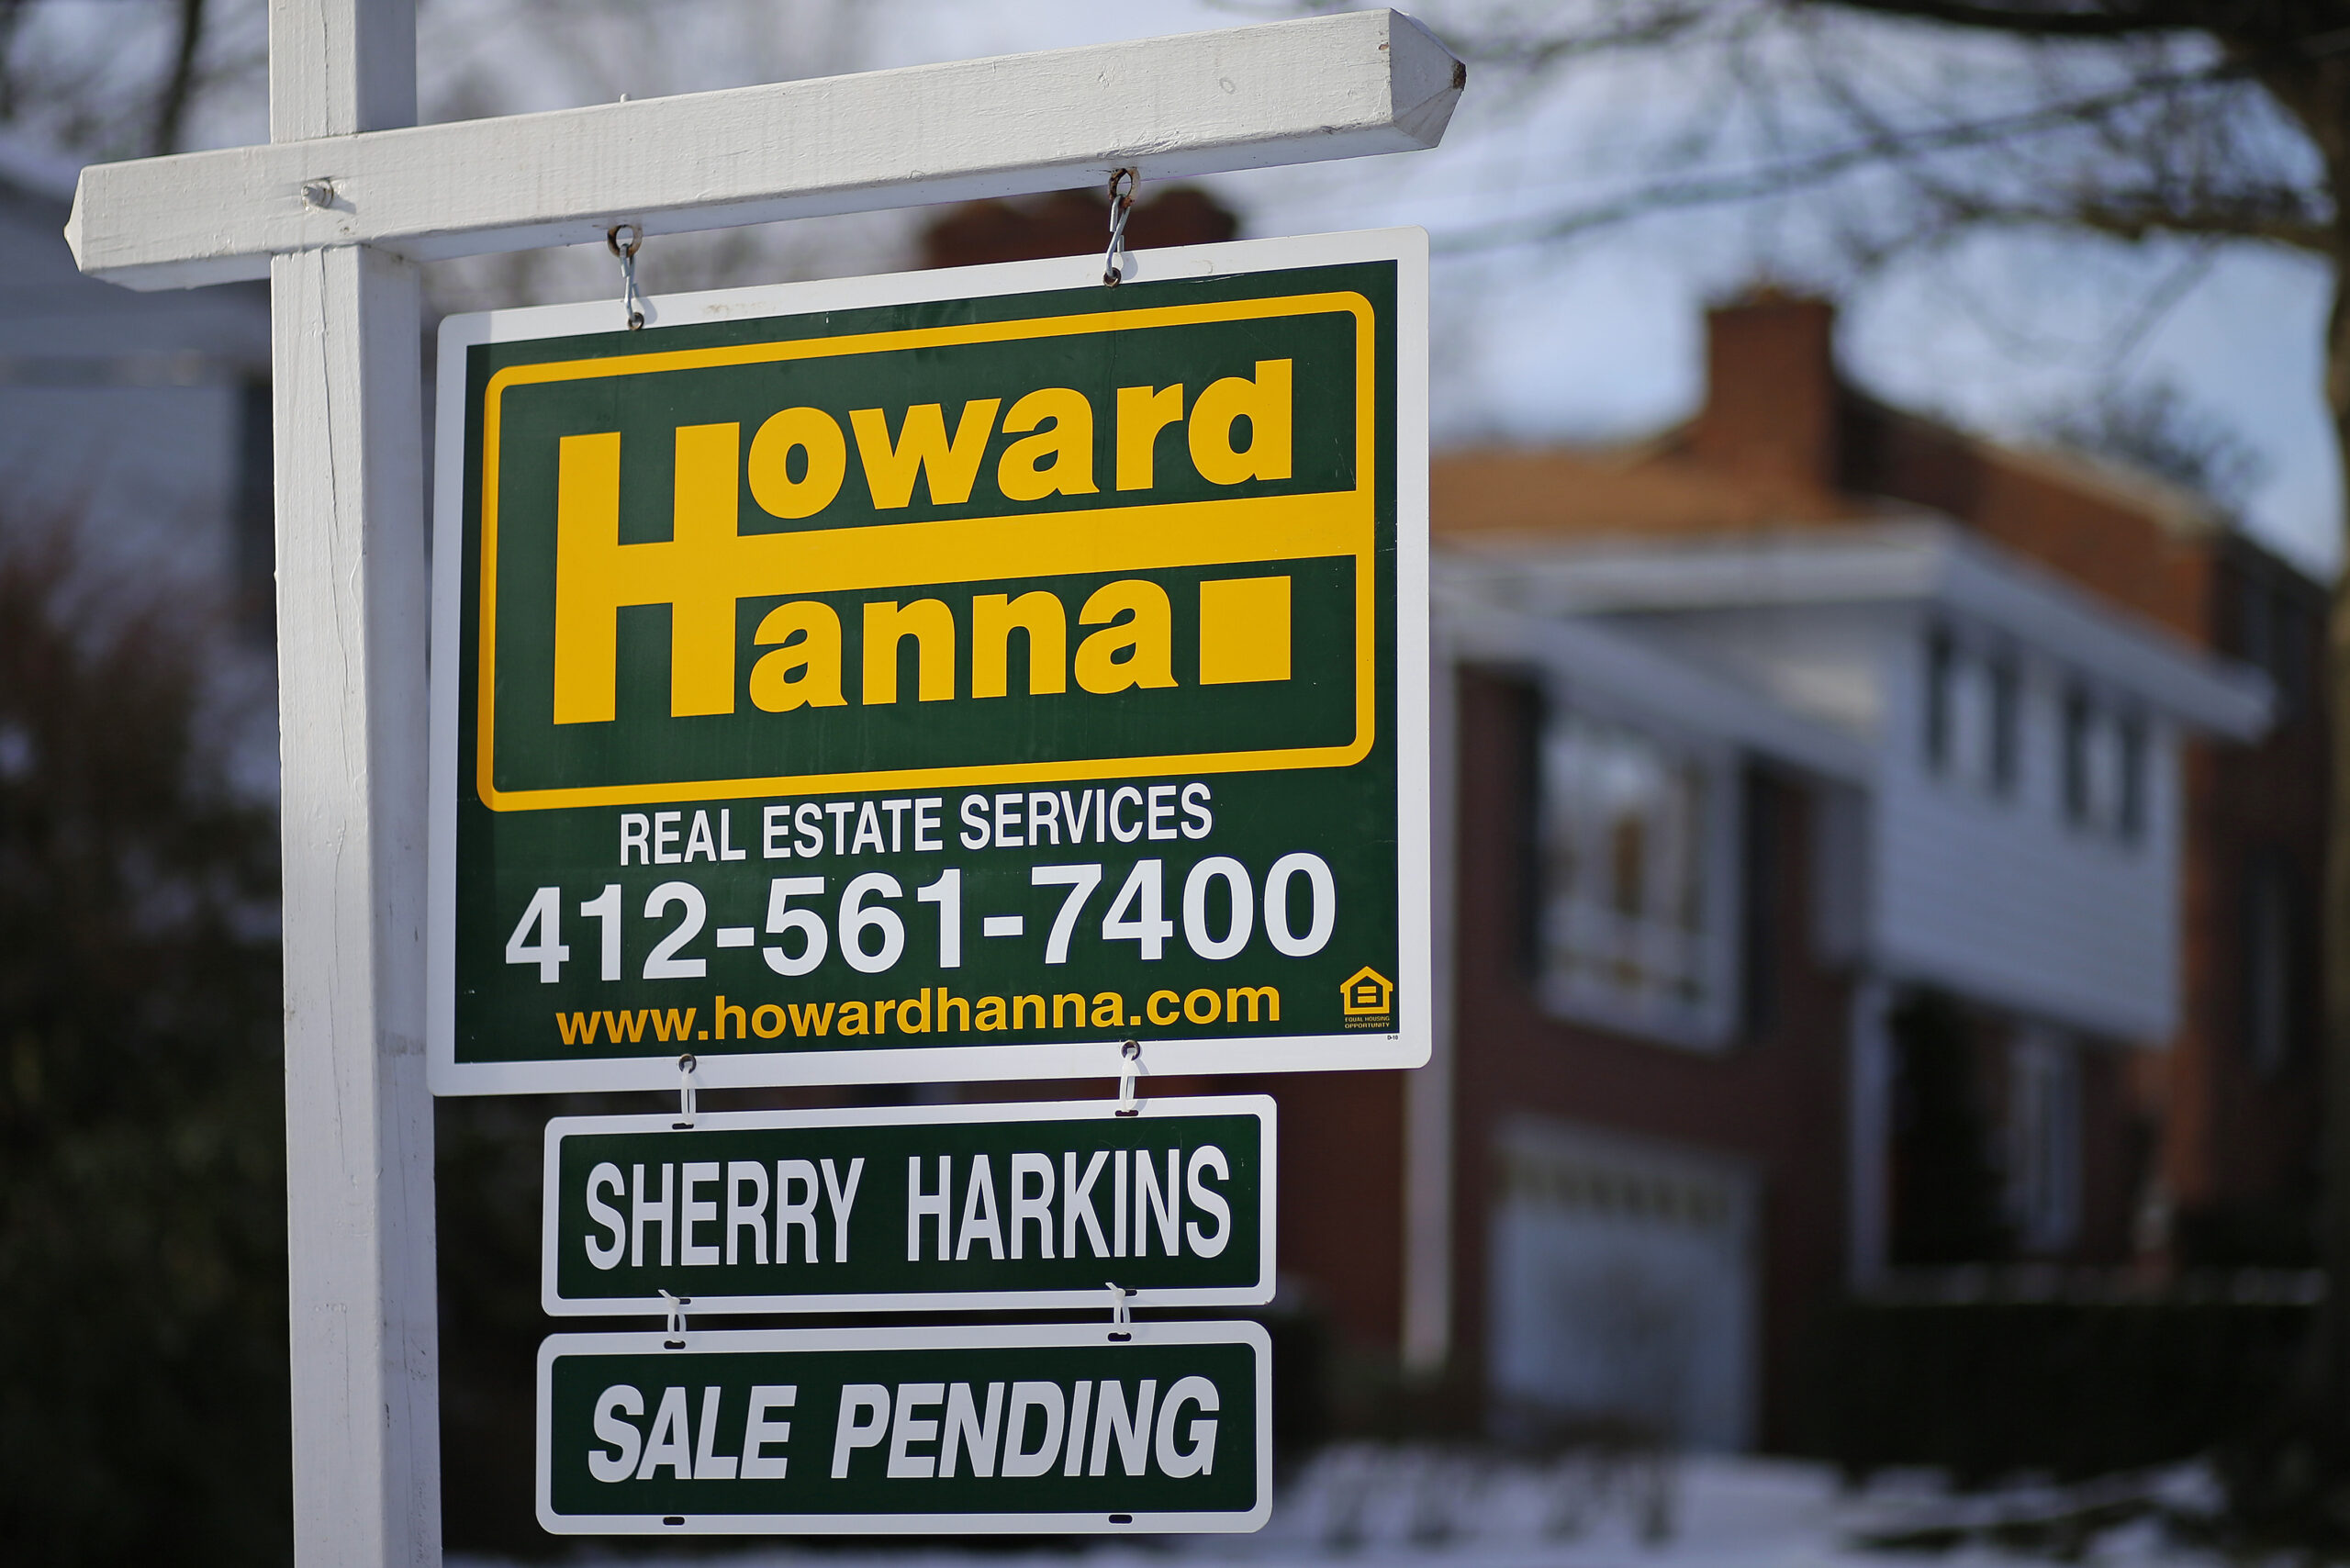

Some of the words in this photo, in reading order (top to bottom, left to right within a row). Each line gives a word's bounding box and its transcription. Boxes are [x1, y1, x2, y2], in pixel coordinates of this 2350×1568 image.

[554, 358, 1292, 606] Howard
[620, 808, 746, 867] REAL
[763, 797, 944, 859] ESTATE
[959, 782, 1213, 850] SERVICES
[505, 852, 1336, 984] 412-561-7400
[555, 986, 1280, 1045] www.howardhanna.com
[585, 1157, 866, 1271] SHERRY
[907, 1145, 1231, 1261] HARKINS
[588, 1384, 798, 1483] SALE
[830, 1375, 1220, 1479] PENDING
